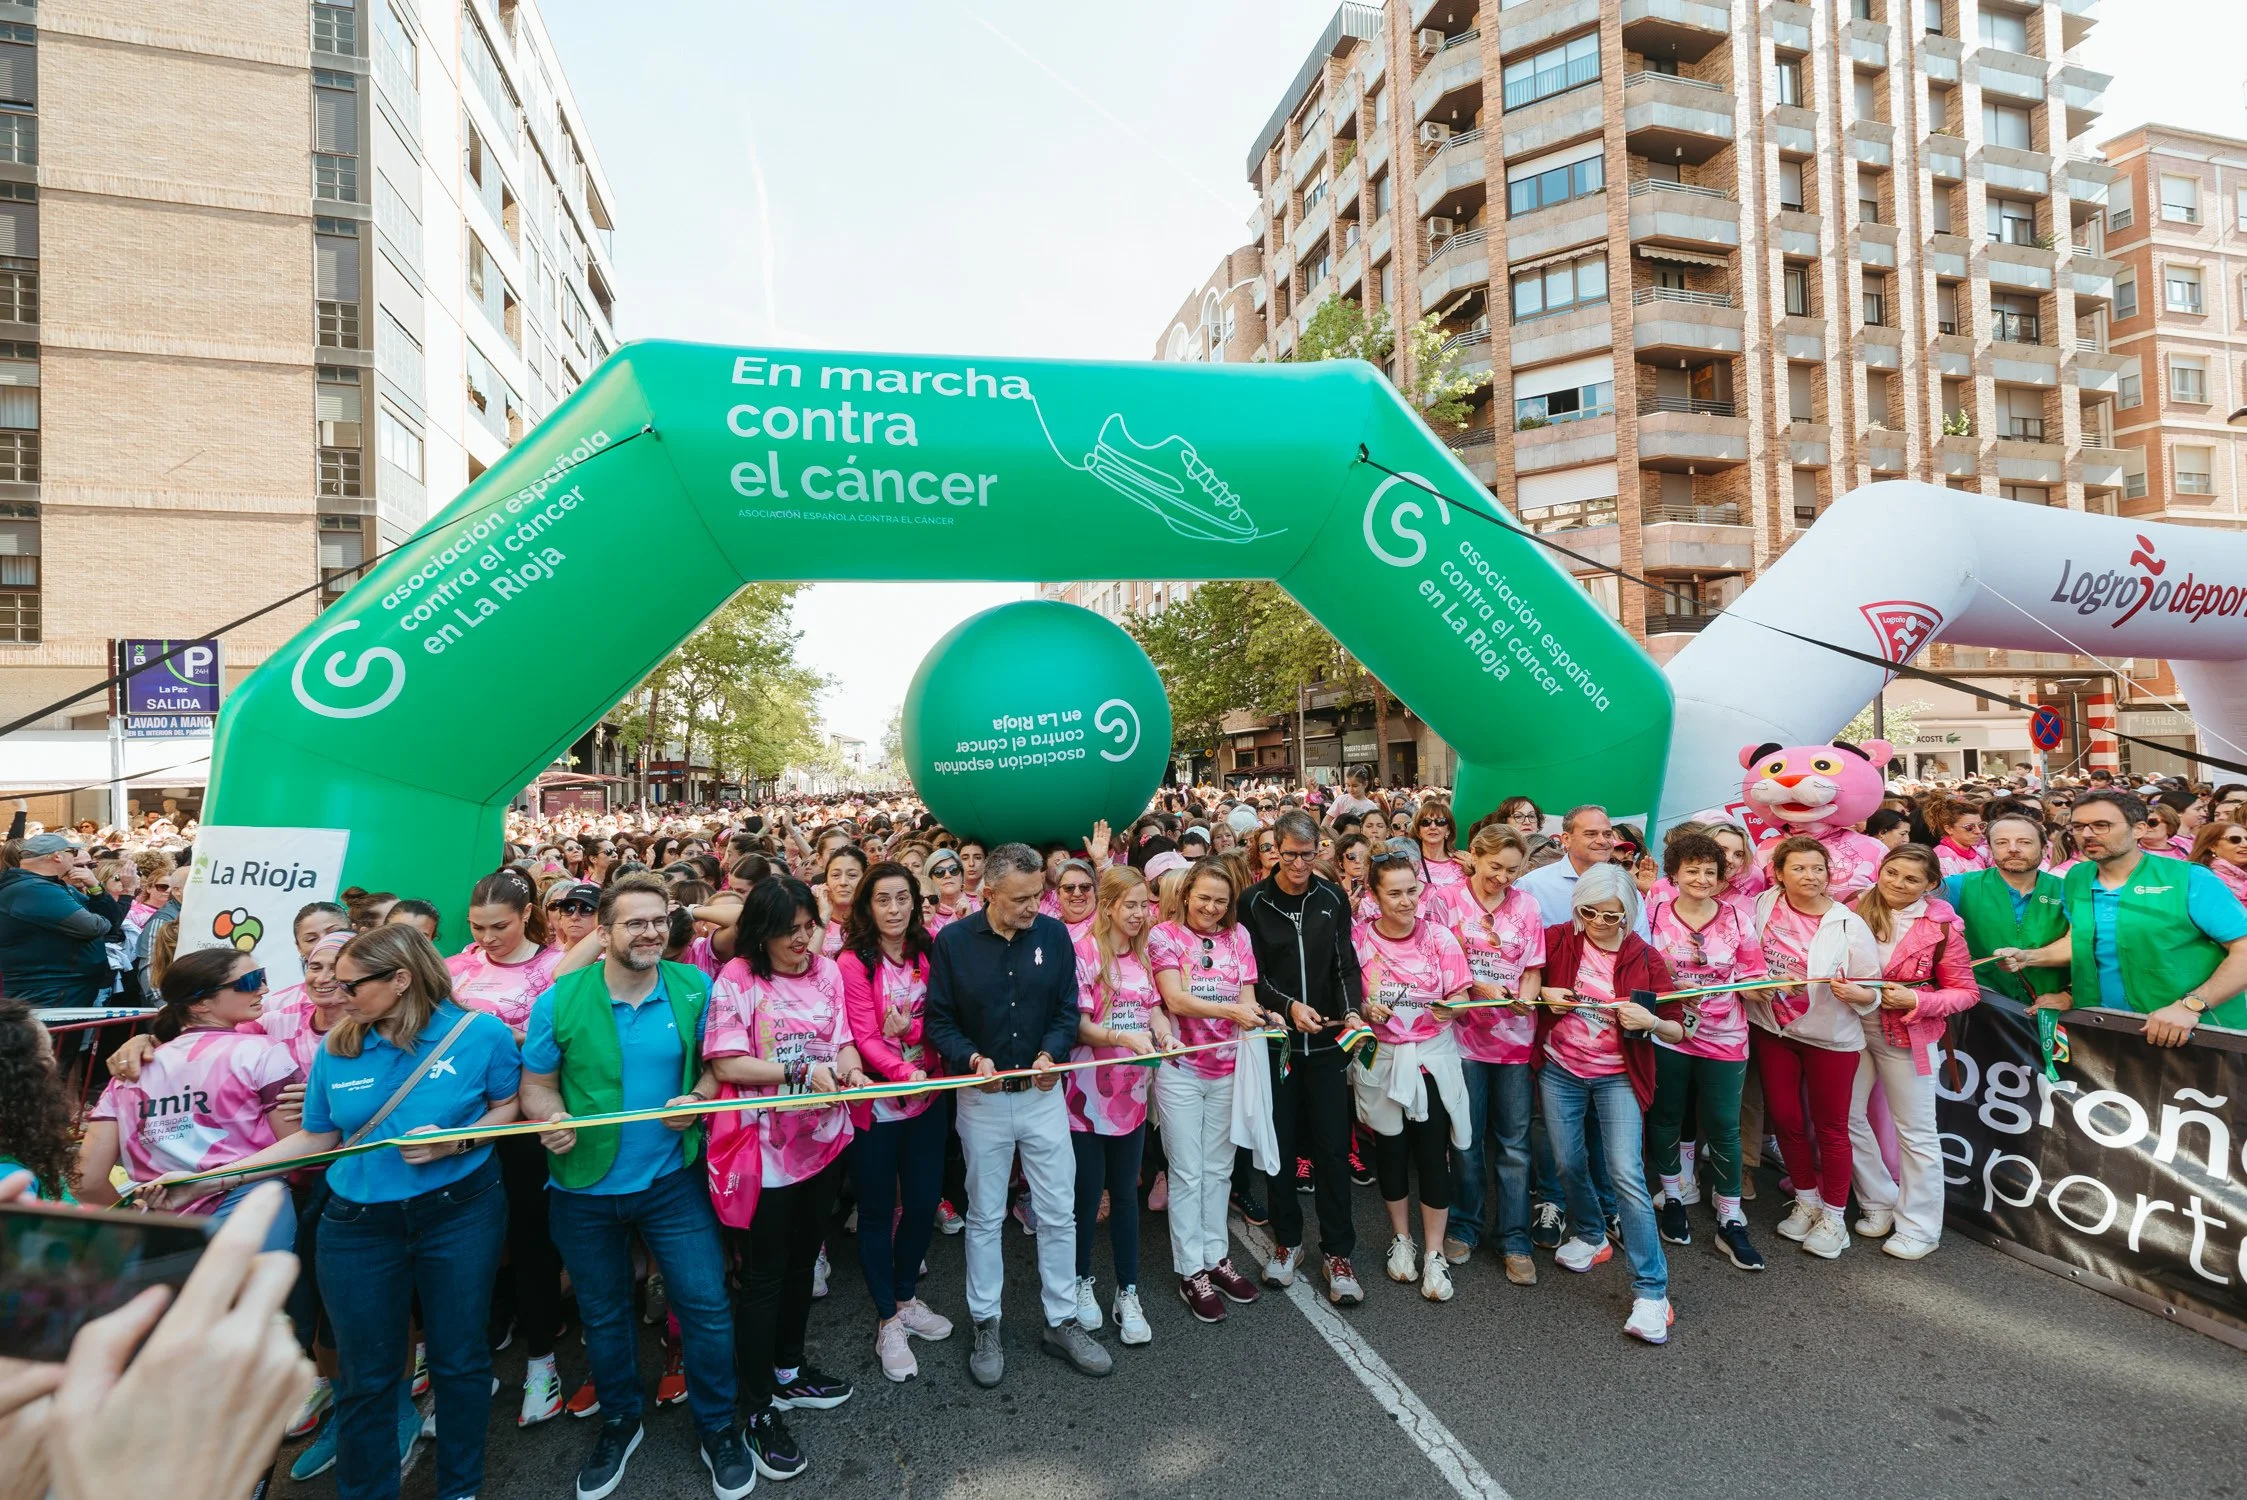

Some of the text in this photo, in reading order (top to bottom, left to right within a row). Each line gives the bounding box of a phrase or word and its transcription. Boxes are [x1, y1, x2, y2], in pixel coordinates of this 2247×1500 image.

[729, 355, 1034, 401] En marcha
[725, 401, 919, 448] contra
[729, 449, 999, 508] el cáncer
[380, 427, 612, 612] asociación española
[737, 508, 955, 526] ASOCIACIÓN ESPAÑOLA CONTRA EL CÁNCER
[399, 482, 587, 633] contra el cáncer
[422, 543, 567, 656] en La Rioja
[2168, 572, 2247, 624] depor
[1418, 576, 1511, 683] en La Rioja
[1440, 560, 1566, 699] contra el cáncer
[1458, 538, 1612, 713] asociación española
[172, 686, 188, 694] Paz
[146, 698, 201, 710] SALIDA
[127, 716, 211, 729] LAVADO A MANO
[992, 709, 1083, 733] en La Rioja
[955, 728, 1085, 754] contra el cáncer
[1916, 735, 1944, 743] ACOSTE
[933, 747, 1086, 776] asociación española
[210, 859, 318, 893] La Rioja
[1465, 936, 1474, 945] XI
[1767, 937, 1776, 945] XI
[1465, 947, 1501, 959] Carrera
[1762, 945, 1798, 963] Carrera
[1481, 959, 1490, 968] la
[1675, 960, 1686, 968] XI
[1776, 959, 1786, 970] la
[1191, 974, 1222, 982] Carrera
[1381, 969, 1391, 977] XI
[1676, 970, 1715, 980] Carrera
[1190, 984, 1215, 993] por la
[1380, 979, 1417, 989] Carrera
[1575, 979, 1584, 989] XI
[1379, 989, 1395, 998] por
[1112, 999, 1141, 1008] Carrera
[1111, 1010, 1135, 1021] por la
[773, 1018, 785, 1029] XI
[774, 1031, 816, 1042] Carrera
[776, 1043, 802, 1057] por la
[1935, 1049, 2247, 1182] ogroñ
[1939, 1132, 2247, 1286] eport
